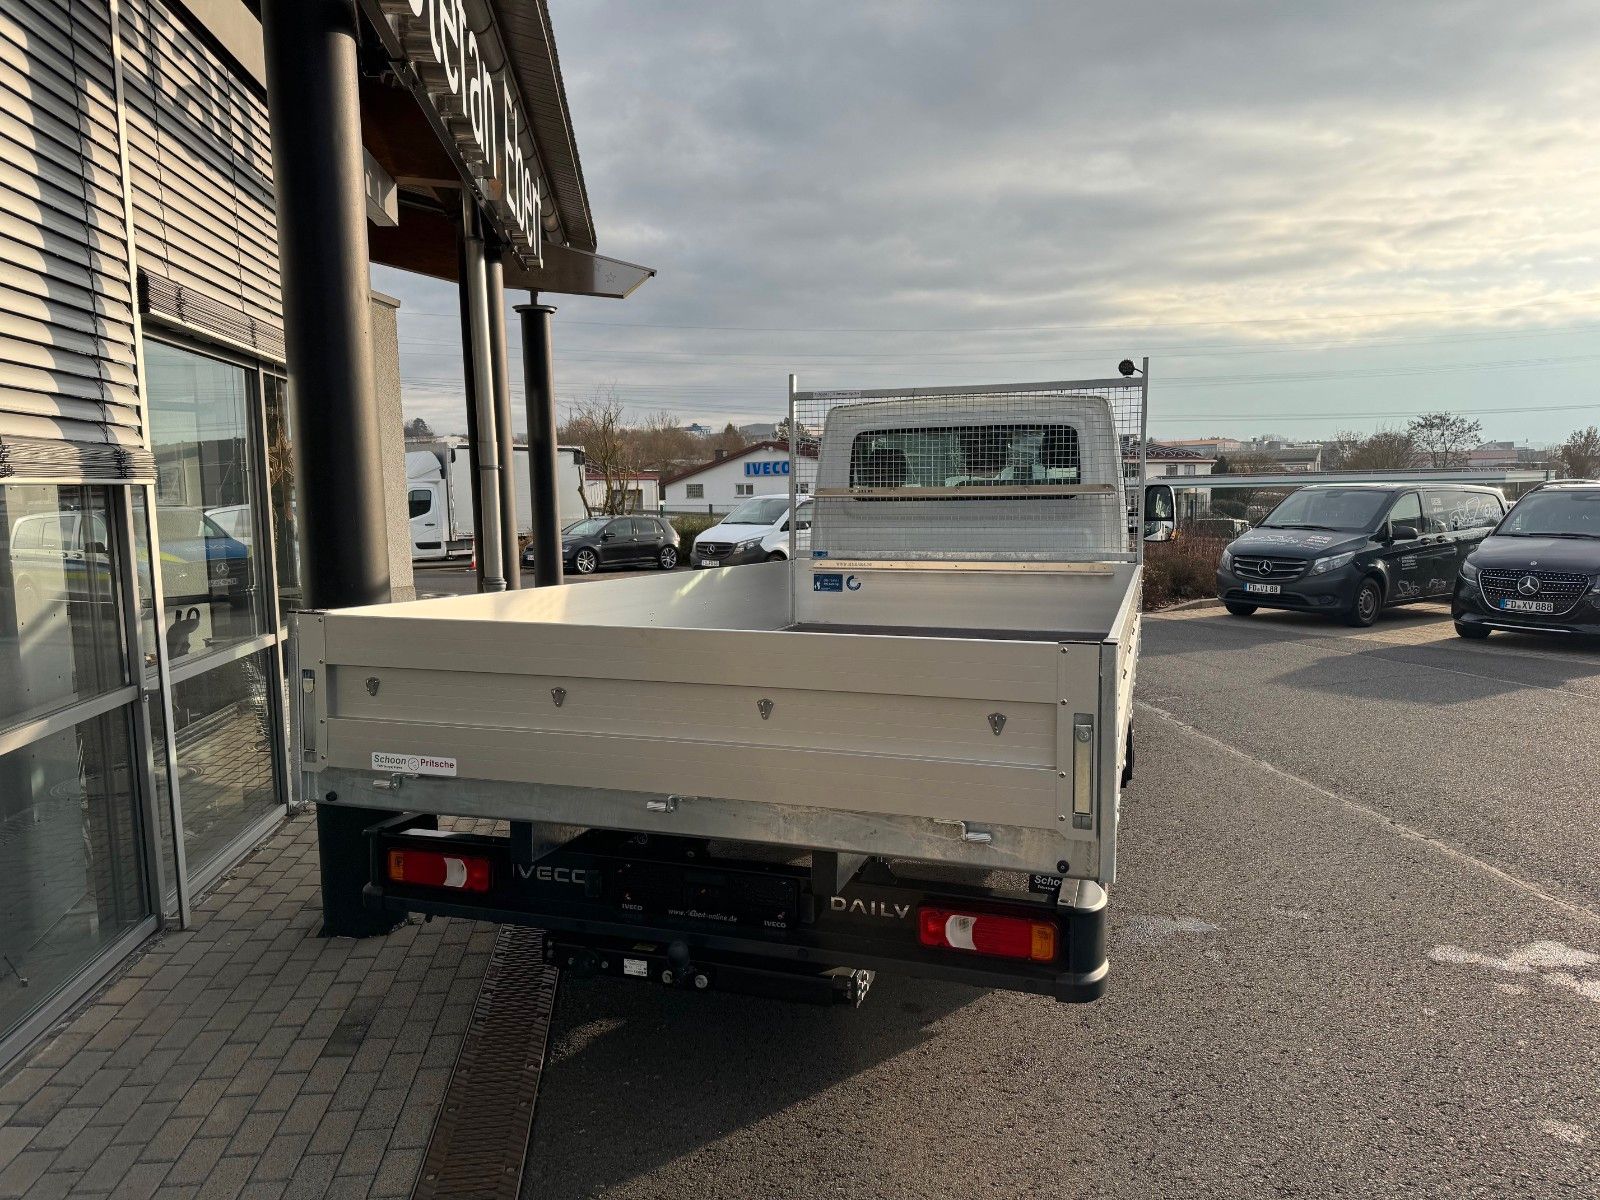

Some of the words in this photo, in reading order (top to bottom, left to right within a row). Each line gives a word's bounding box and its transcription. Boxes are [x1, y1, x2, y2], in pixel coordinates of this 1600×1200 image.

[503, 72, 544, 269] Ebert
[746, 462, 790, 475] IVECO
[1505, 600, 1517, 609] FD
[1522, 601, 1534, 610] XV
[1535, 602, 1553, 612] 888
[373, 754, 407, 765] Schoon
[420, 758, 455, 769] Pritsche
[1034, 874, 1060, 887] Scho
[621, 903, 643, 911] IVECO
[830, 896, 910, 919] DAILY
[764, 920, 787, 928] IVECO
